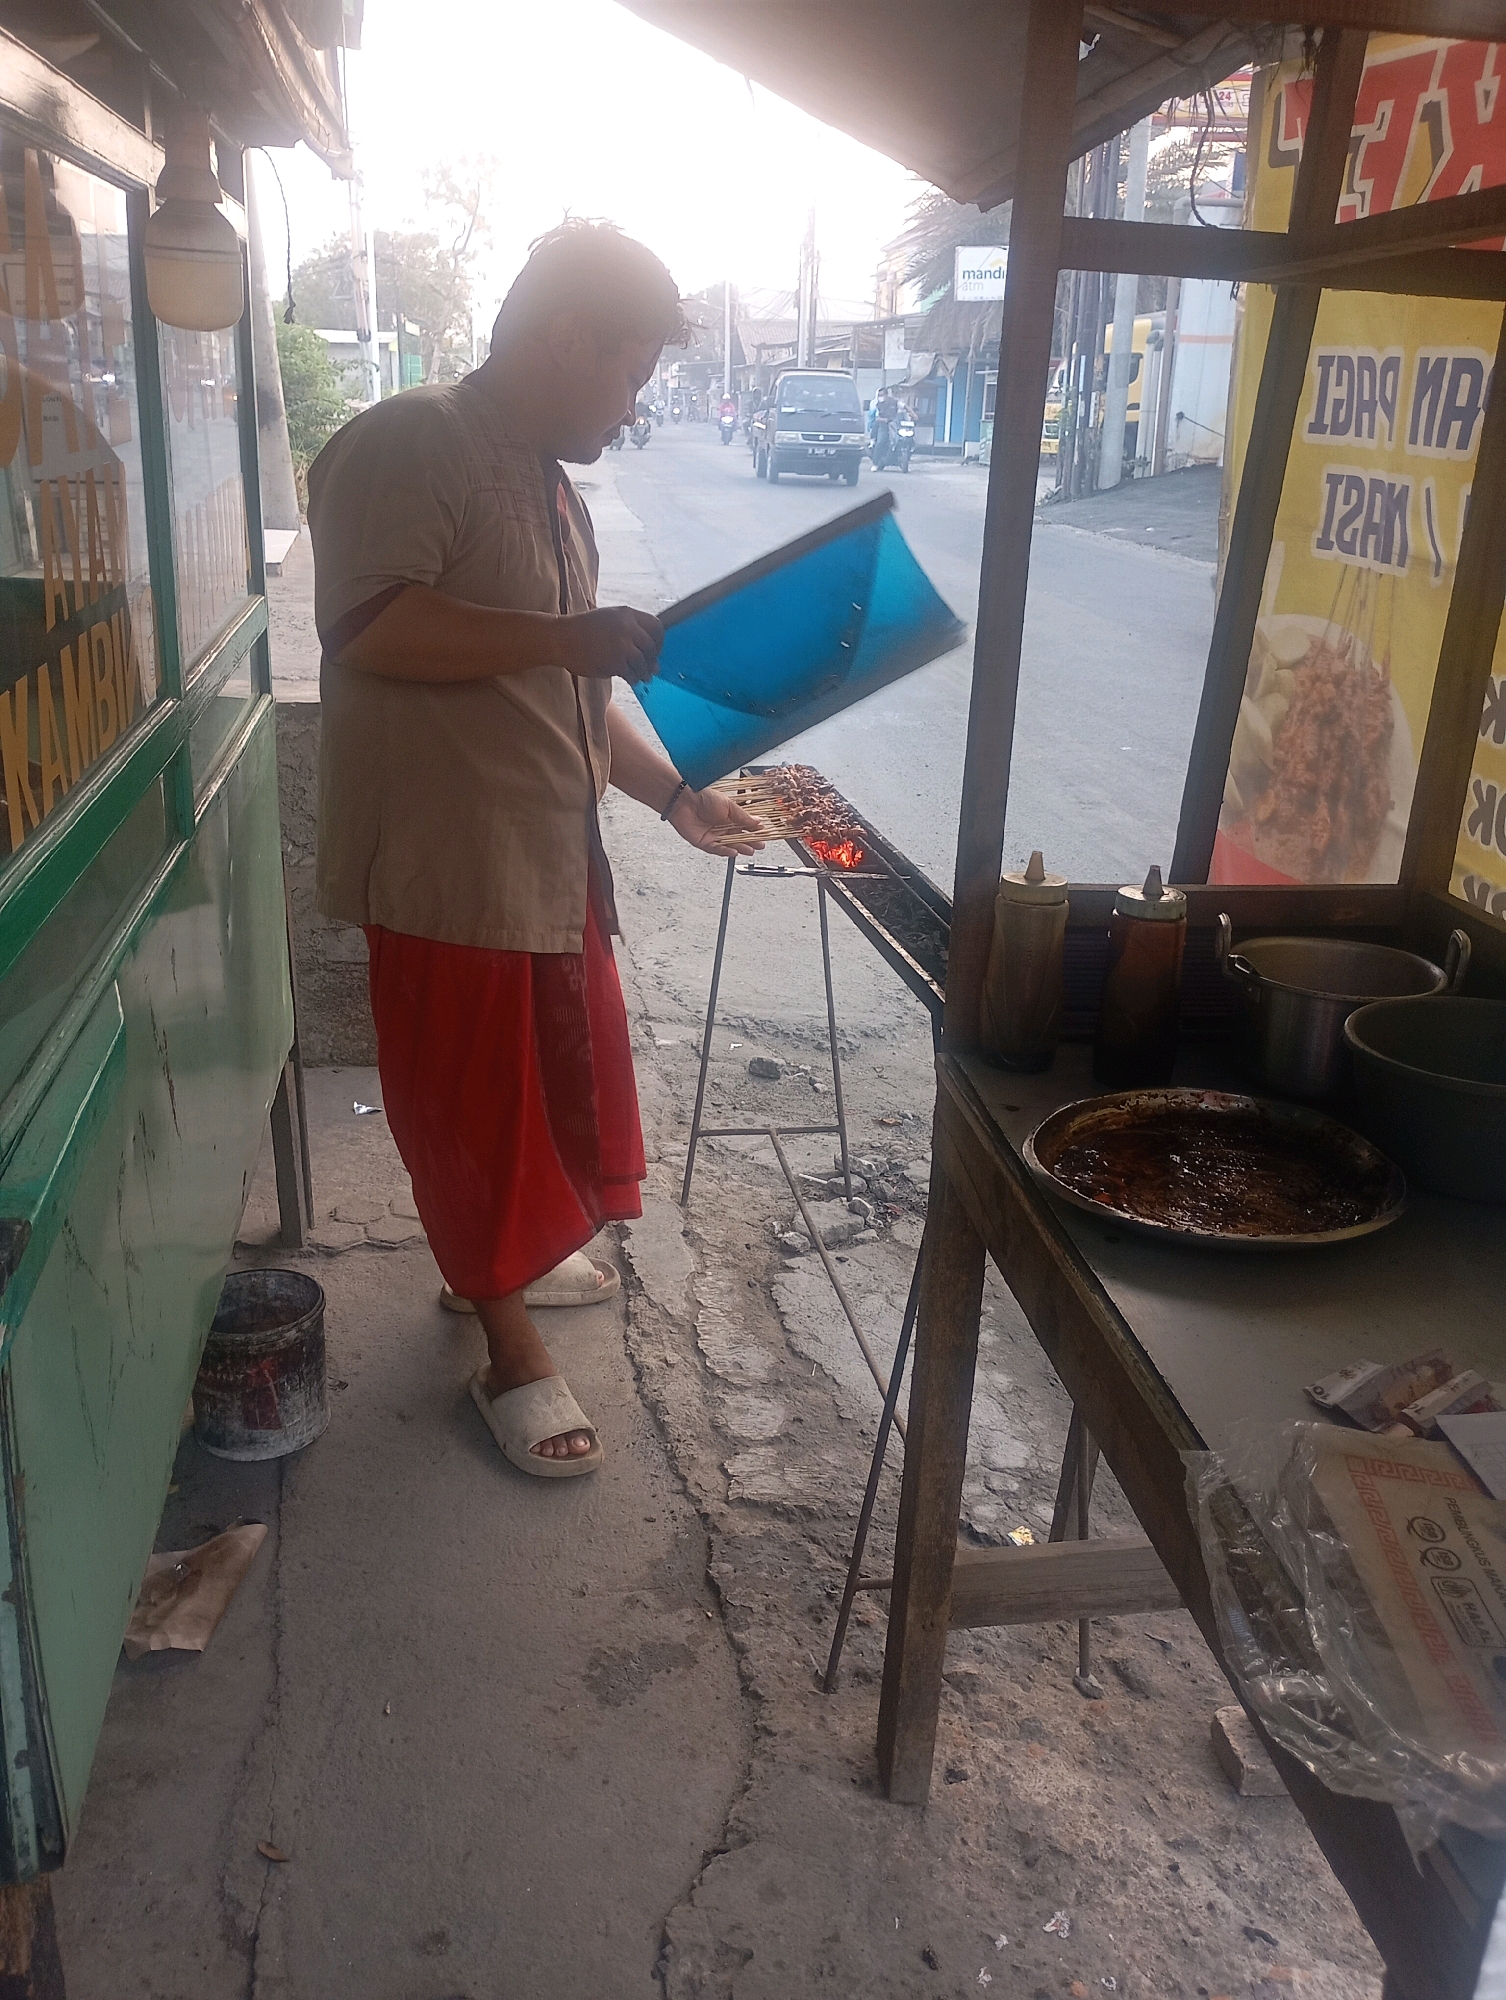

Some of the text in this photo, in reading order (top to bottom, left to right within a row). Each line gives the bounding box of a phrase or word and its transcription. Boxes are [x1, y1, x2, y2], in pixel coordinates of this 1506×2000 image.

[962, 281, 984, 292] atm
[40, 462, 128, 633] AYAM
[177, 472, 252, 656] MADURA
[0, 586, 161, 853] KAMBING
[1463, 1602, 1494, 1644] HALAL
